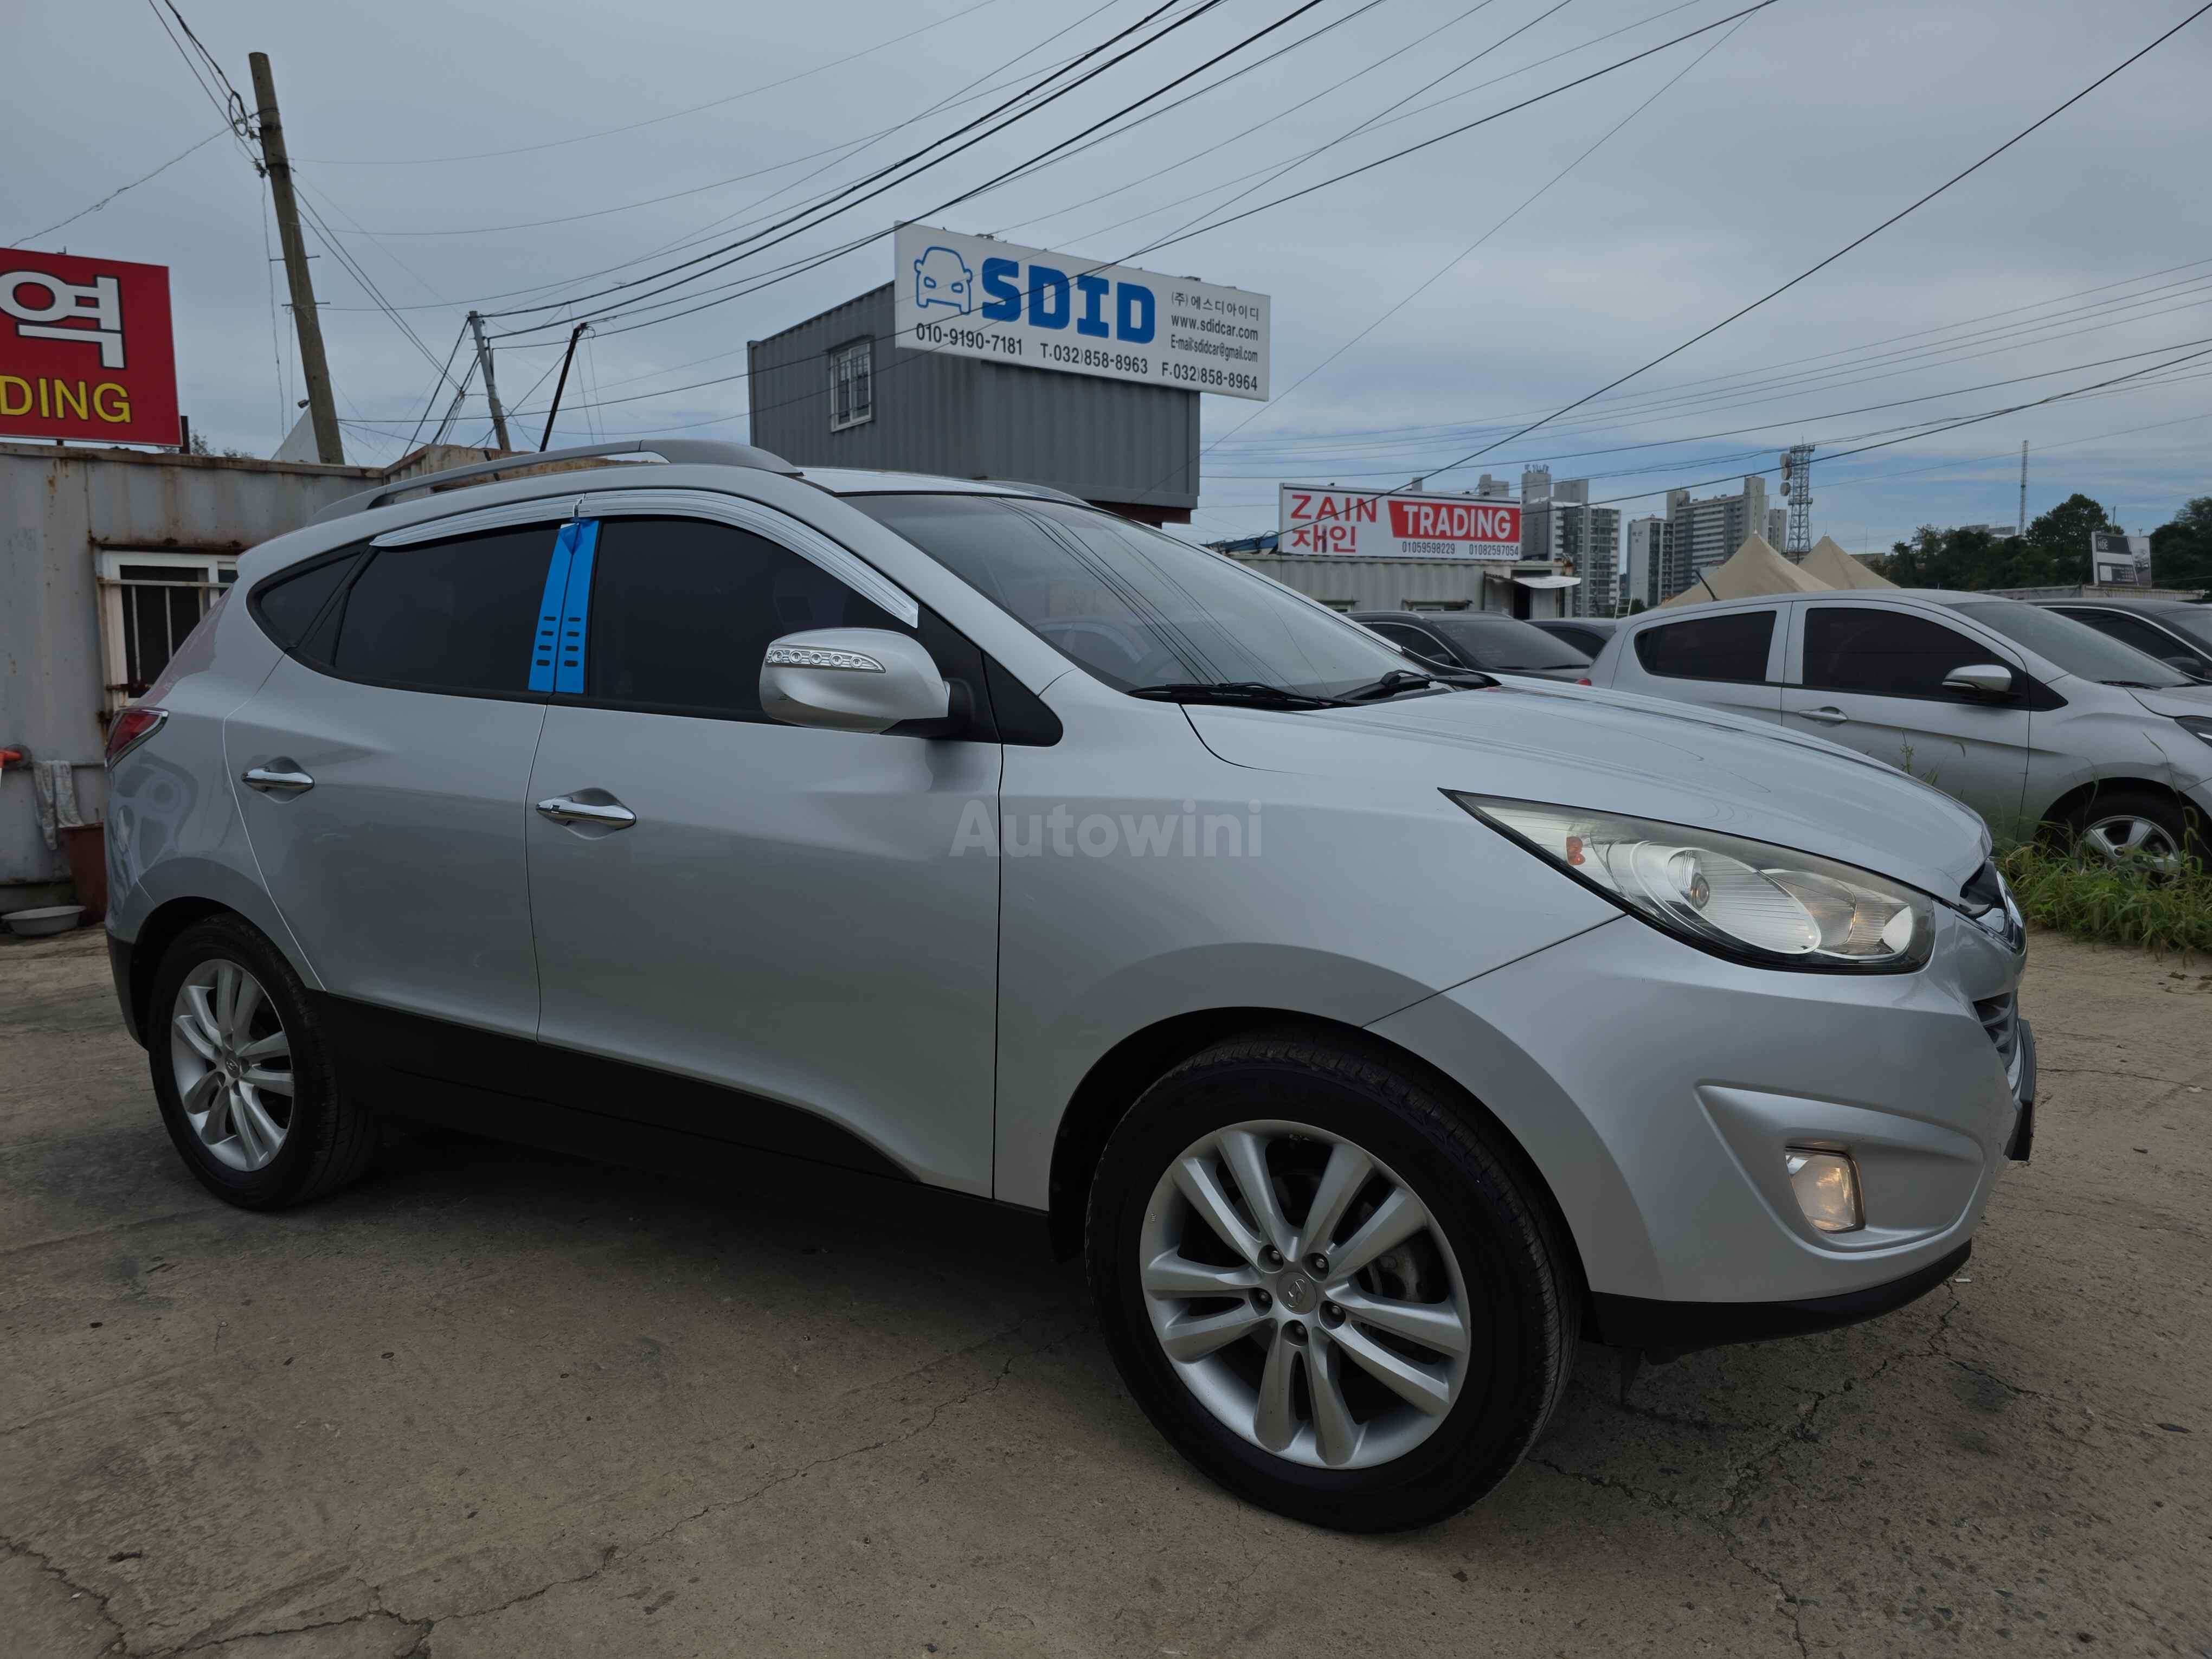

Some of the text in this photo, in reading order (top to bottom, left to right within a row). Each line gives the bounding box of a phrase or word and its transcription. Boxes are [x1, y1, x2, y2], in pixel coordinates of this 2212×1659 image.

[0, 271, 125, 369] 역
[982, 258, 1155, 344] SDID
[1171, 315, 1258, 340] www.sdidcar.com
[916, 323, 1258, 391] 010-9190-7181 T.032)858-8963 F.032)858-8964
[0, 375, 131, 423] DING
[1291, 494, 1377, 522] ZAIN
[1403, 505, 1511, 539] TRADING
[1292, 524, 1356, 553] 재인
[1402, 541, 1519, 556] 01059598229 01082597054
